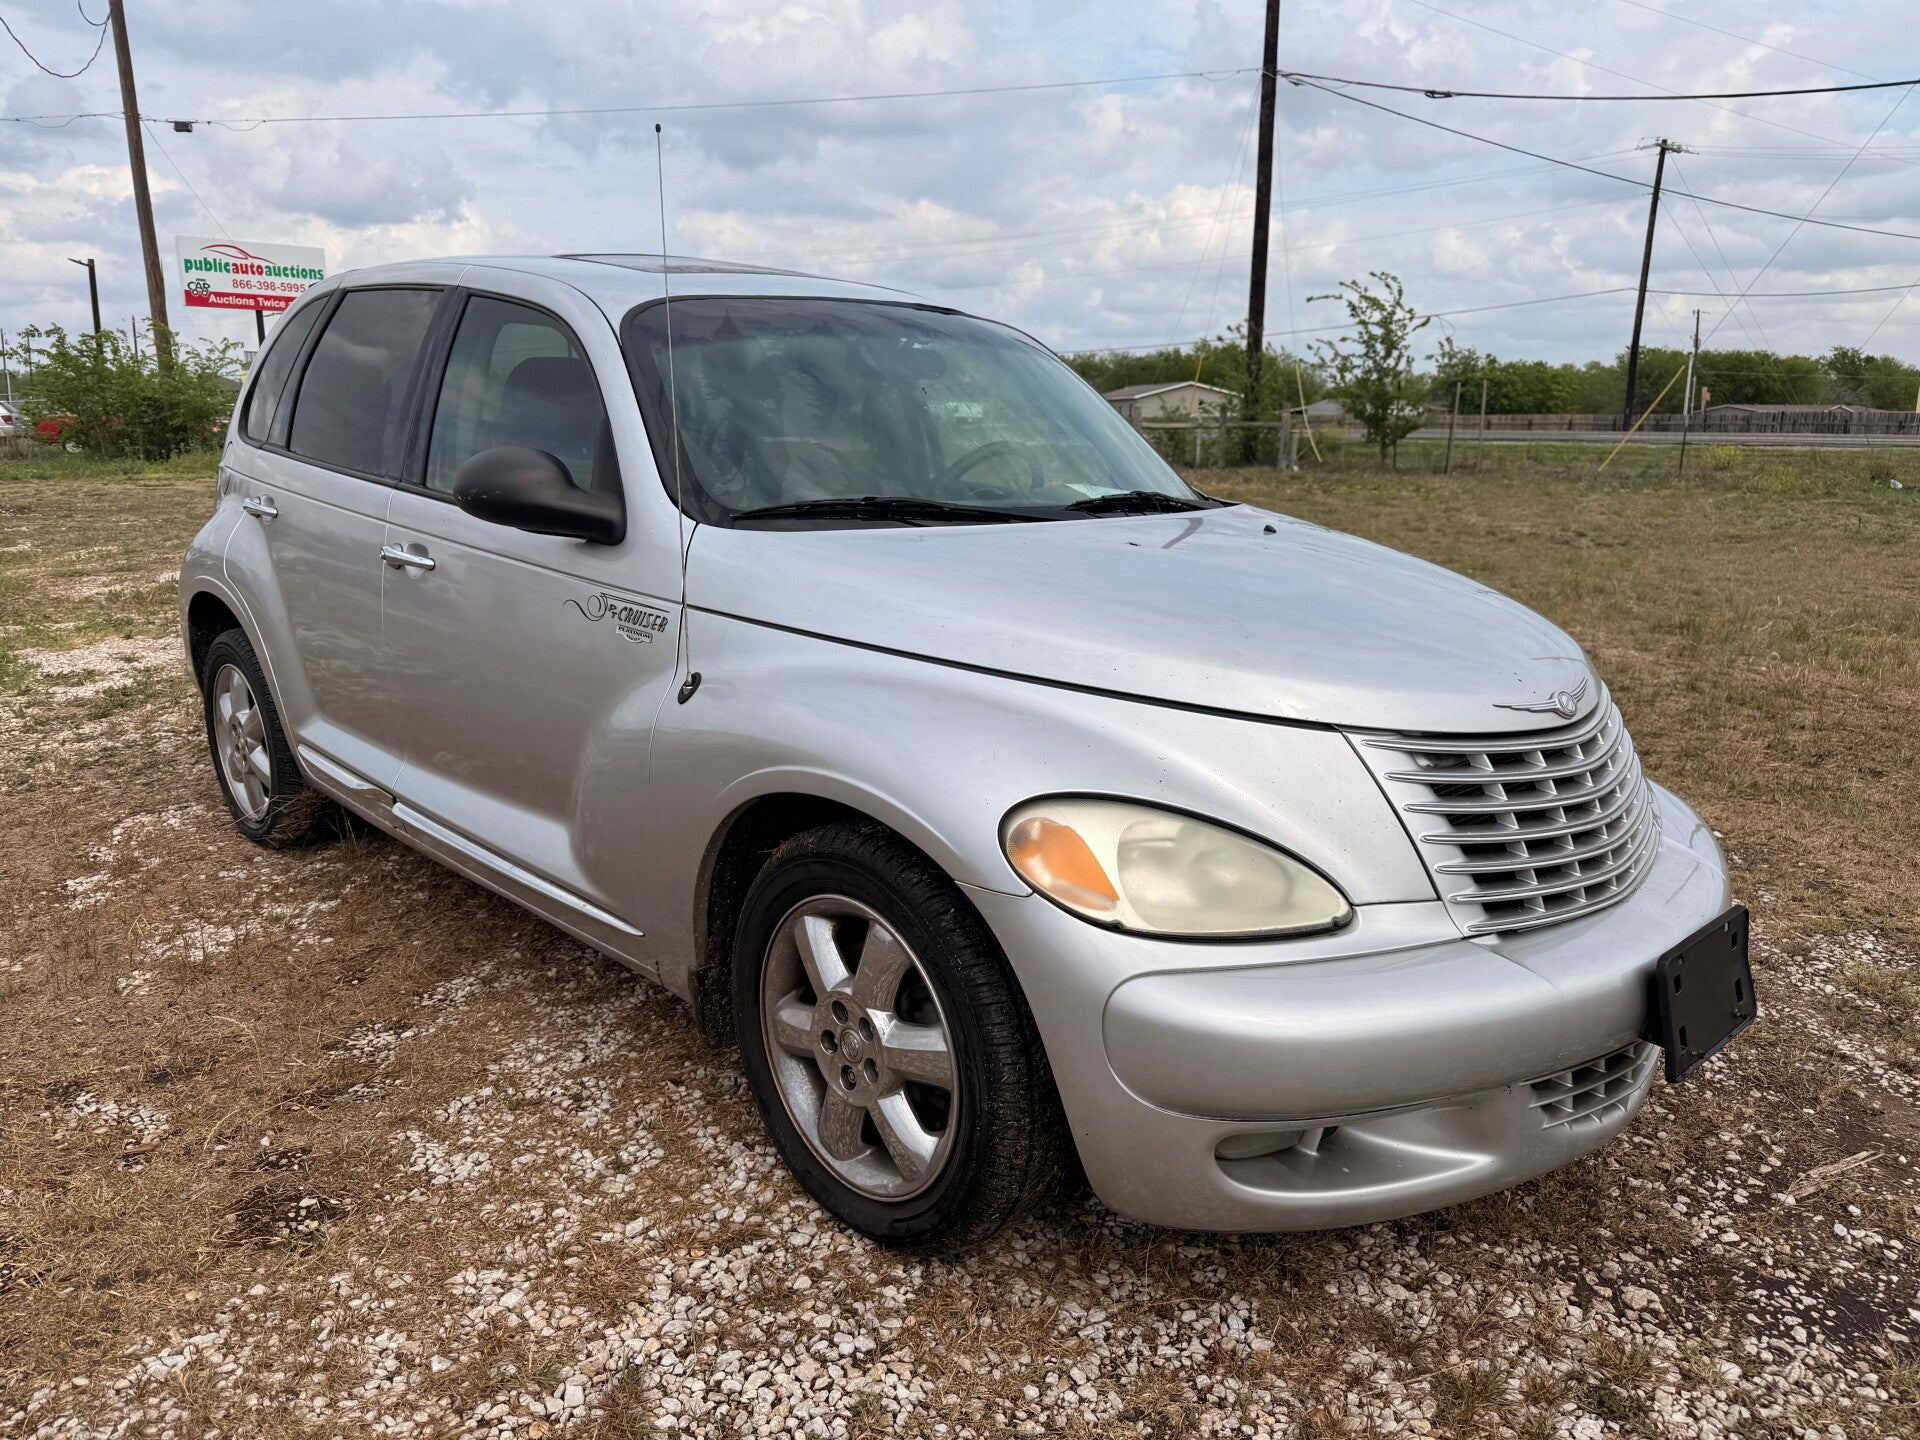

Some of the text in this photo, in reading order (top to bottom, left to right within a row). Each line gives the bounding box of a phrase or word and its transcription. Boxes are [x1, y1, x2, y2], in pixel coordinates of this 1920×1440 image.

[183, 258, 324, 280] publicautoauctions
[187, 281, 211, 293] CAR
[232, 279, 306, 293] 866-398-5995
[208, 294, 255, 306] Auctions
[257, 297, 285, 308] Twice
[618, 606, 668, 632] CRUISER
